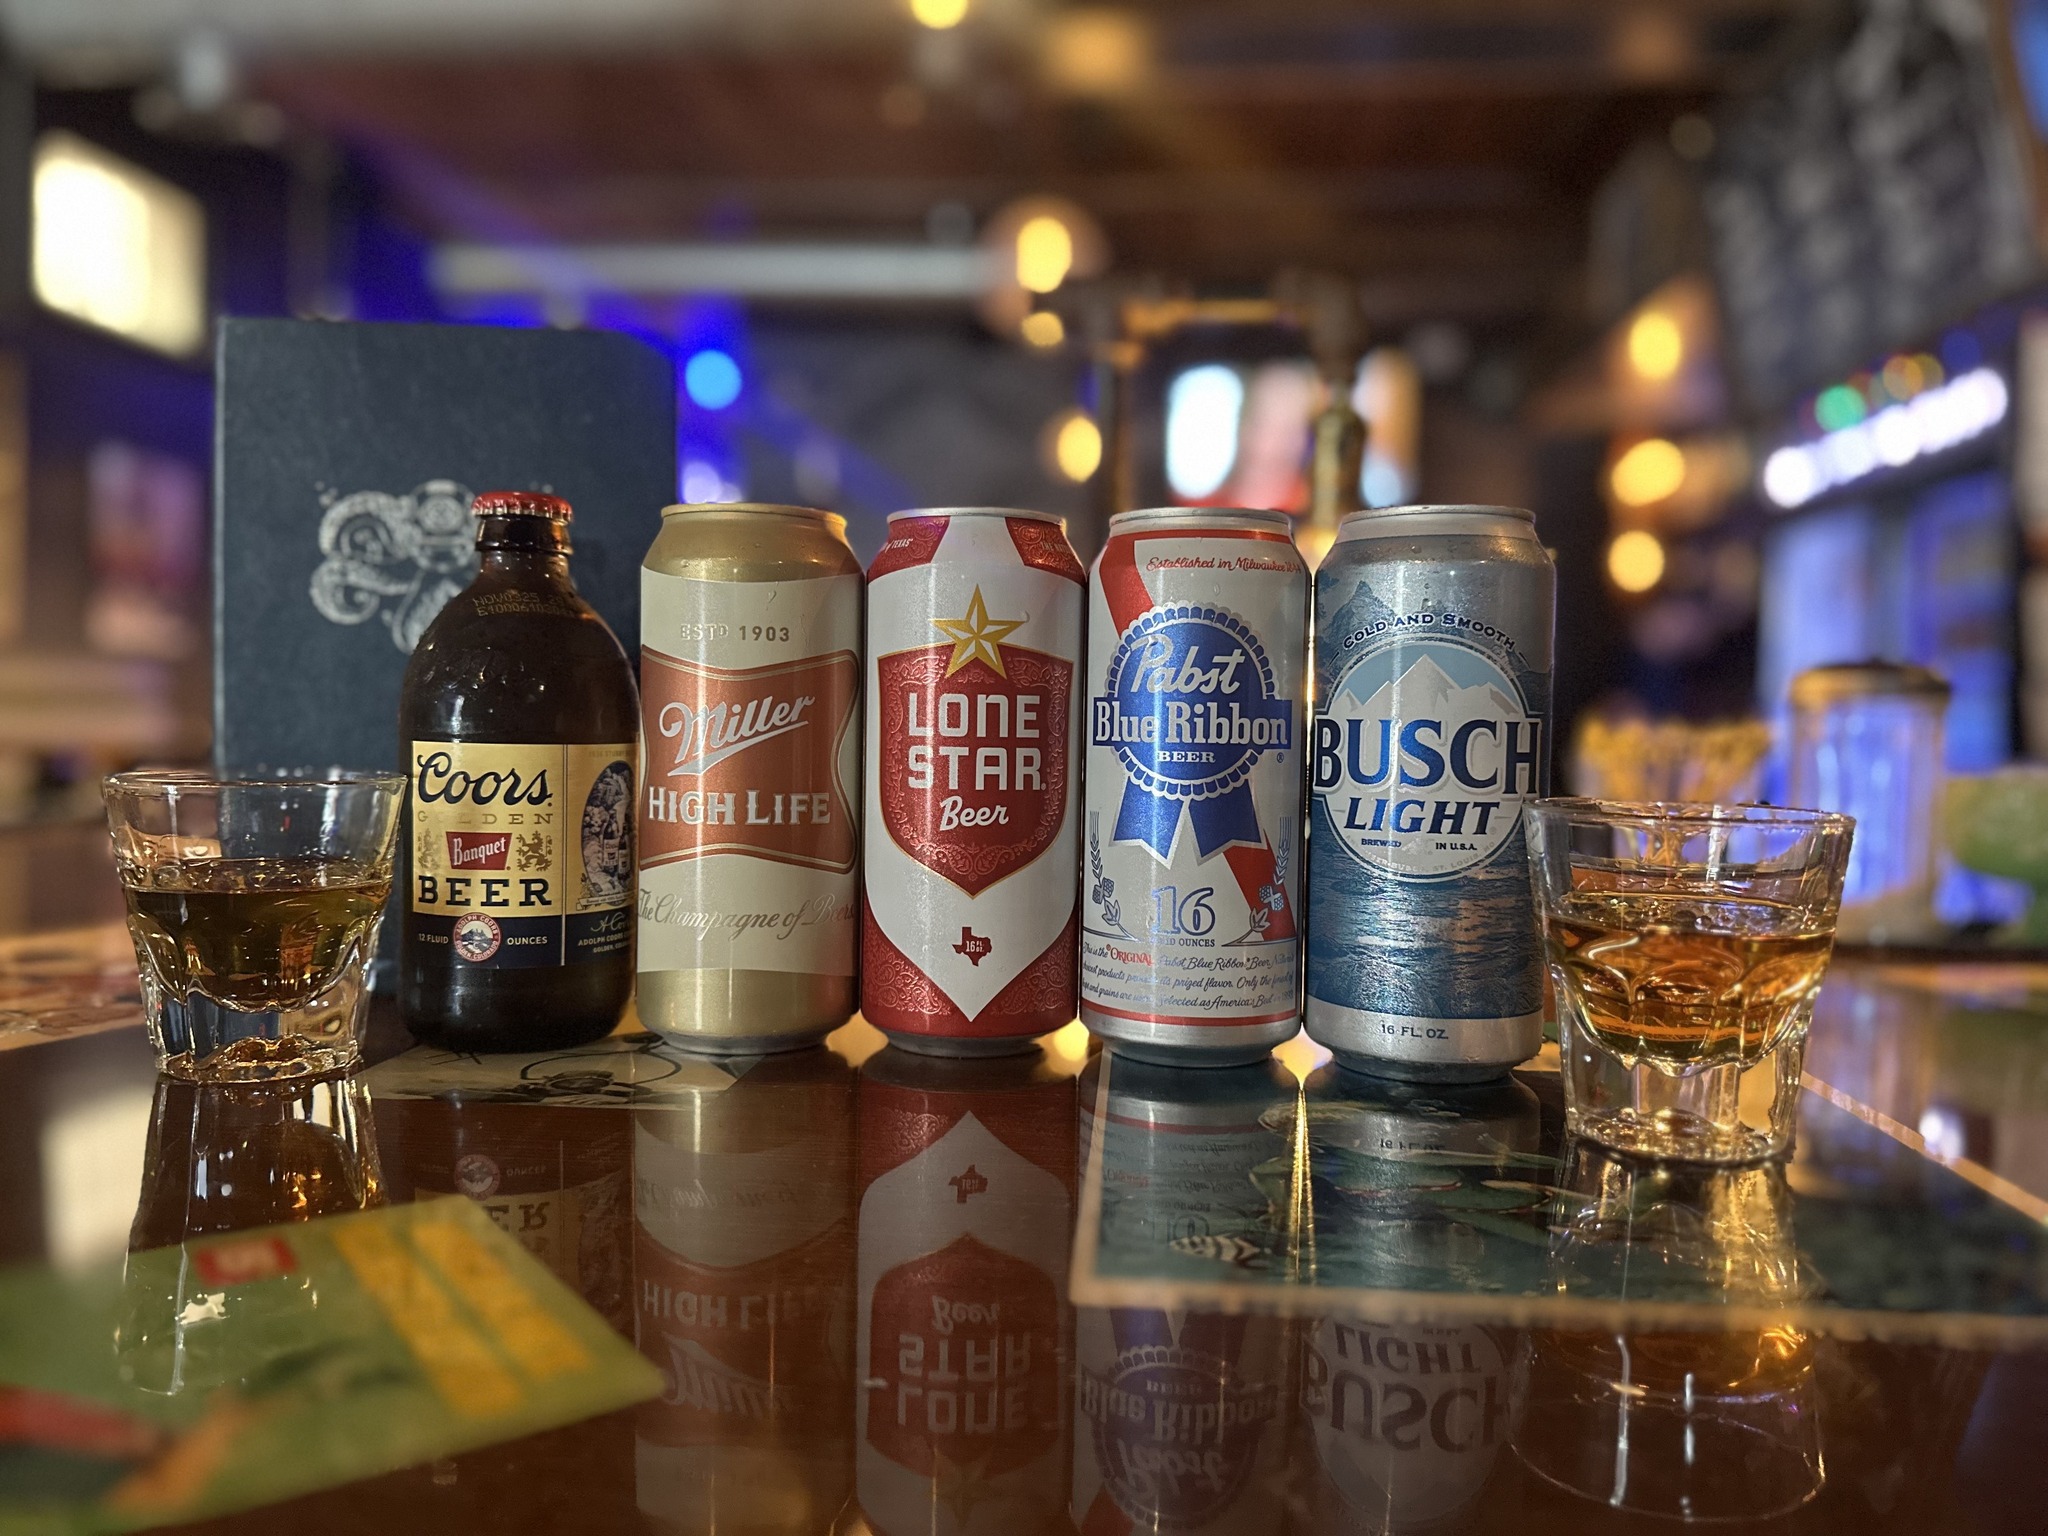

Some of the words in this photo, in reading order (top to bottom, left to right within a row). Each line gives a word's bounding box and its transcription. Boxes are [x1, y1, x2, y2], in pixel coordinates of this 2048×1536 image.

[1146, 556, 1215, 572] Established
[1218, 559, 1233, 571] in
[1230, 556, 1285, 573] Milwaukee
[739, 625, 790, 642] 1903
[1343, 621, 1387, 650] COLD
[1394, 613, 1434, 628] AND
[1130, 633, 1245, 695] Pabst
[659, 695, 815, 766] Miller
[908, 692, 1040, 739] LONE
[1095, 700, 1162, 744] Blue
[1166, 700, 1288, 746] Ribbon
[907, 745, 1042, 791] STAR
[1157, 751, 1216, 764] BEER
[1314, 717, 1540, 795] BUSCH
[417, 751, 553, 807] Coors
[418, 809, 554, 826] GLDEN
[648, 785, 736, 825] HIGH
[745, 788, 831, 826] LIFE
[940, 795, 1009, 831] Beer
[1343, 797, 1500, 836] LIGHT
[452, 836, 507, 866] Banquet
[1435, 842, 1447, 850] IN
[1449, 843, 1478, 851] U.S.A.
[417, 875, 552, 908] BEER
[638, 888, 654, 922] The
[654, 893, 778, 941] Champagne
[777, 899, 810, 941] of
[1151, 885, 1216, 937] 16
[418, 933, 426, 941] 12
[427, 935, 449, 944] FLUID
[507, 936, 548, 946] OUNCES
[965, 940, 976, 952] 16
[1178, 938, 1215, 948] OUNCES
[1097, 967, 1126, 981] products
[1171, 976, 1205, 991] prized
[1236, 976, 1258, 991] Only
[1183, 956, 1214, 971] Blue
[1119, 991, 1133, 1000] are
[1199, 999, 1211, 1007] as
[1381, 1022, 1395, 1035] 16
[1400, 1025, 1422, 1038] FL.
[1426, 1027, 1449, 1040] OZ.
